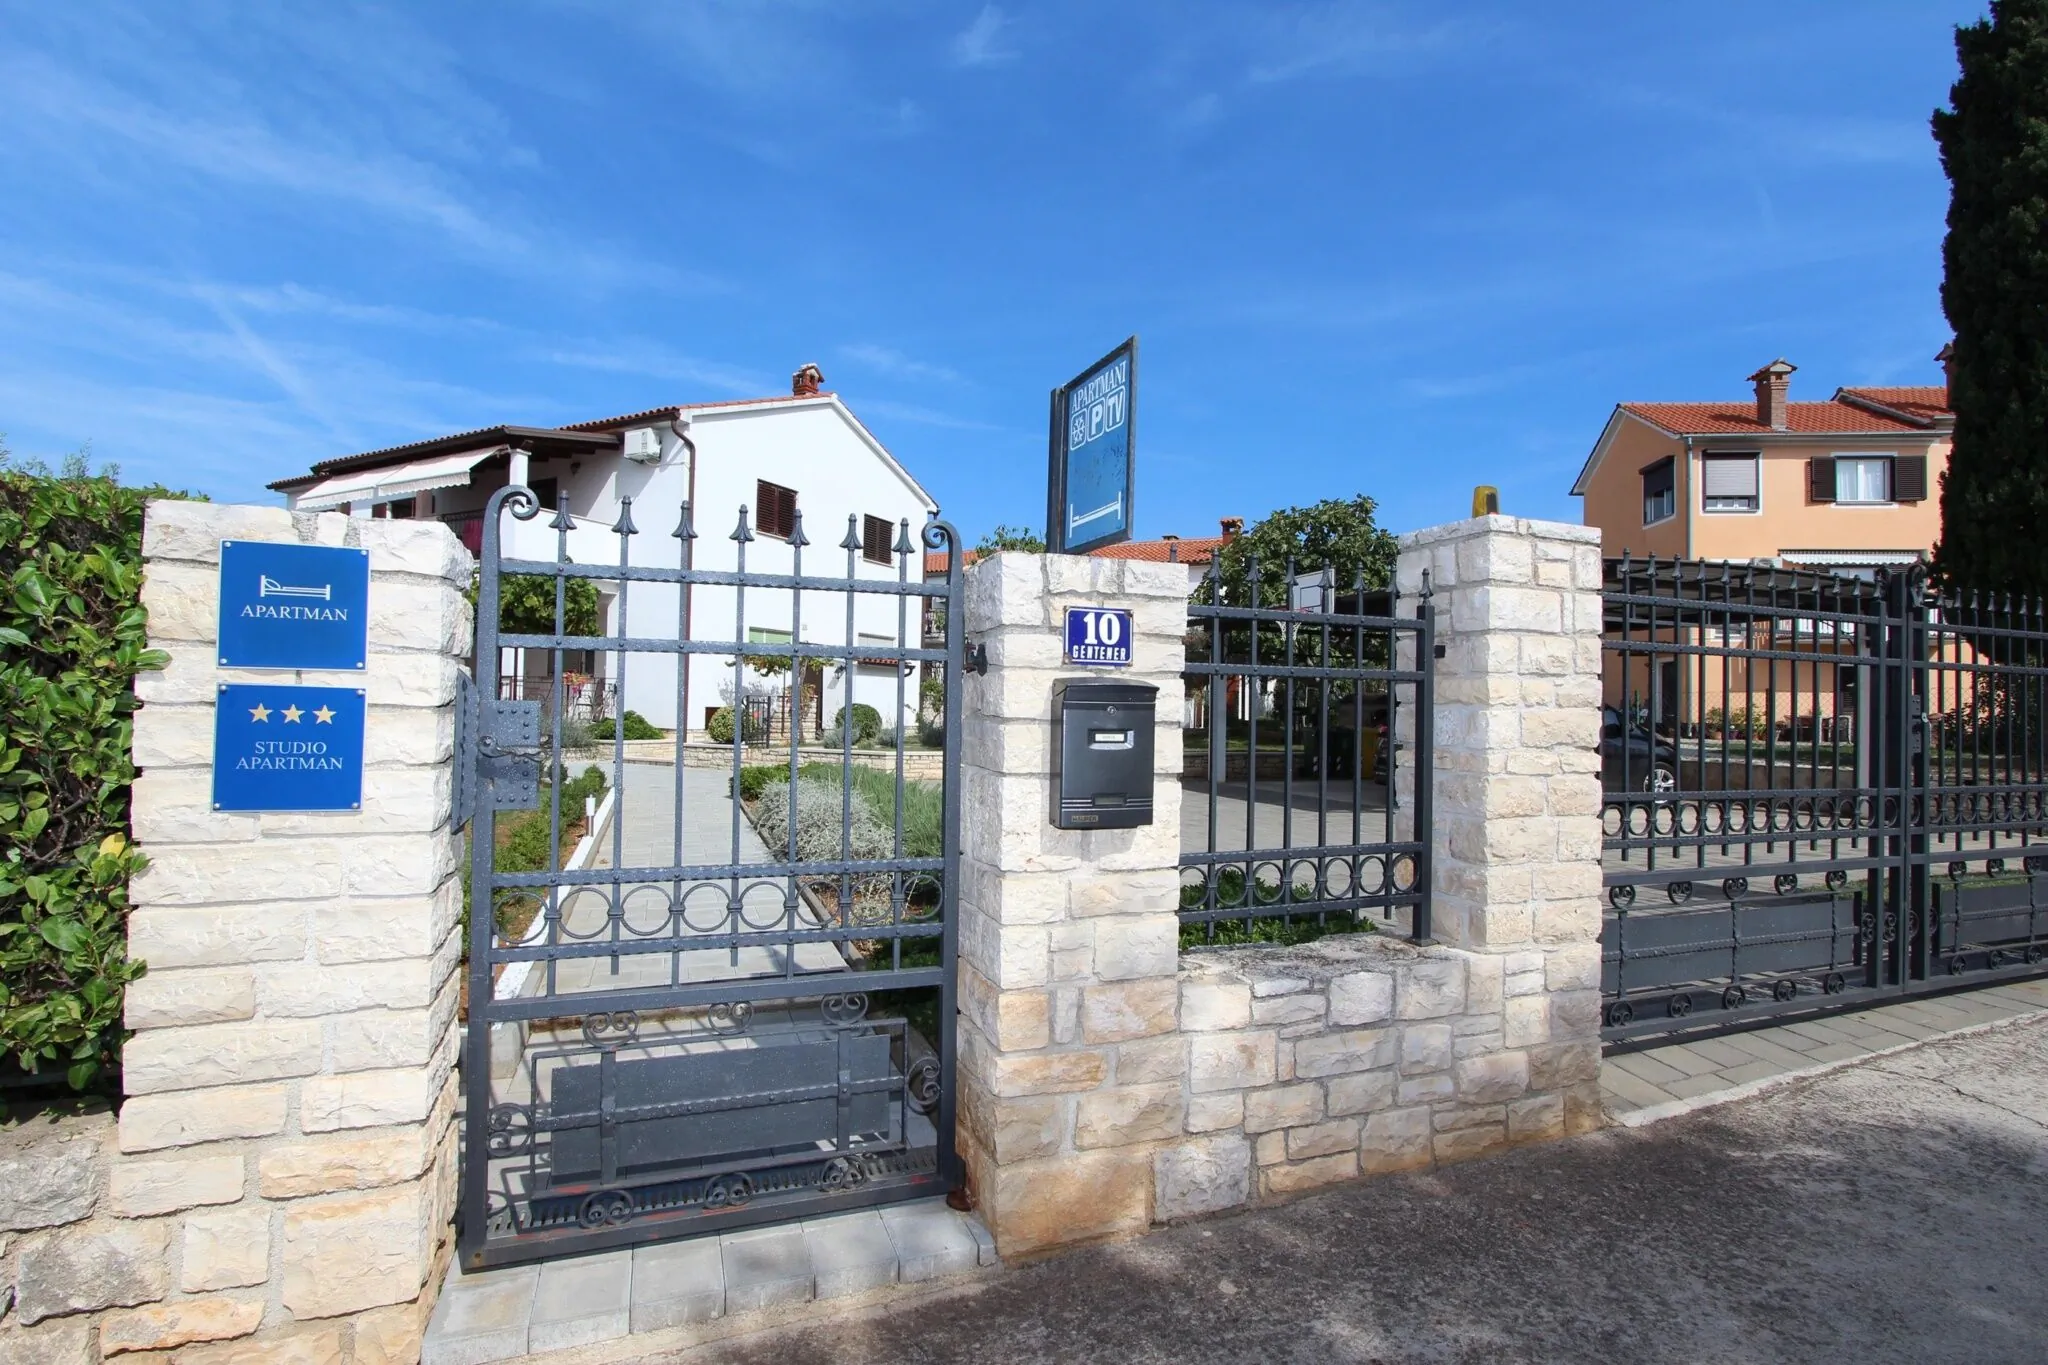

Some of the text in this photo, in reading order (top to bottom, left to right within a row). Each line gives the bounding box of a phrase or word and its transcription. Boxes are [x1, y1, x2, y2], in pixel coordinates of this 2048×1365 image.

[1072, 361, 1127, 412] APARTMANI
[1092, 392, 1123, 435] P TV
[241, 605, 348, 621] APARTMAN
[1083, 612, 1121, 645] 10
[1072, 645, 1126, 660] GENTENER
[255, 741, 327, 755] STUDIO
[236, 757, 343, 770] APARTMAN
